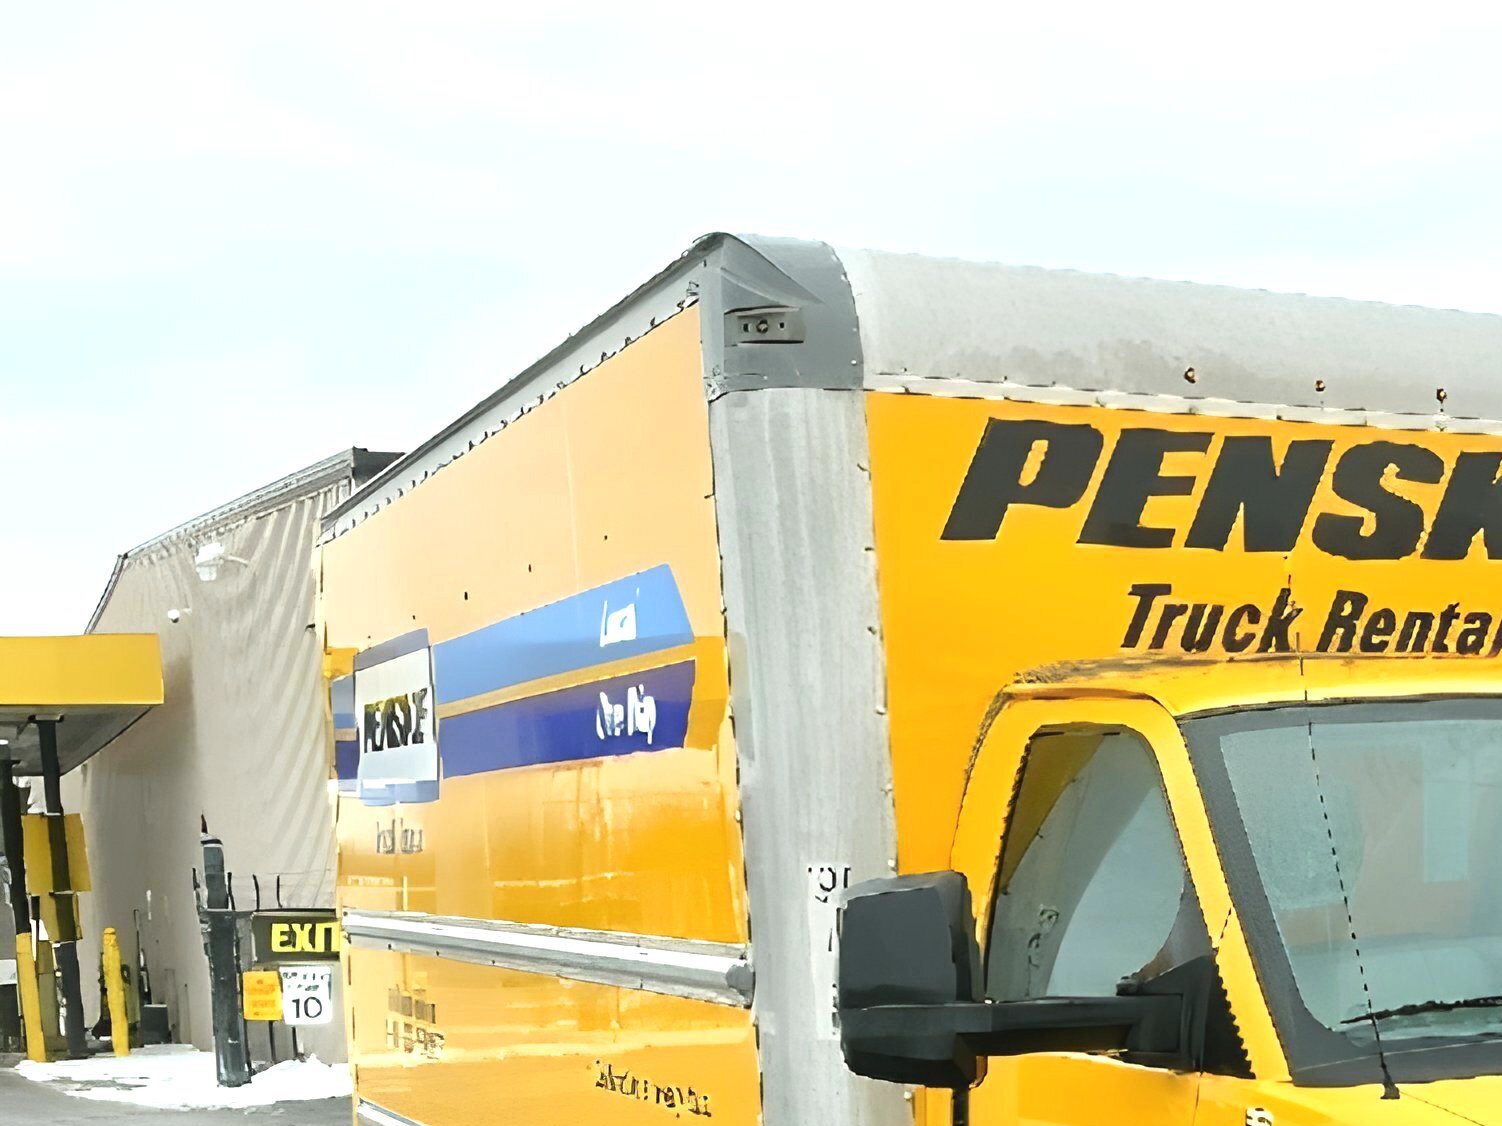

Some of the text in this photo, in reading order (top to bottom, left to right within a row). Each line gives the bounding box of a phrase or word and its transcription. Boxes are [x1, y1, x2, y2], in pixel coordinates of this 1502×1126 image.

[1121, 583, 1303, 653] Truck
[271, 922, 340, 953] EXIT
[291, 996, 323, 1019] 10
